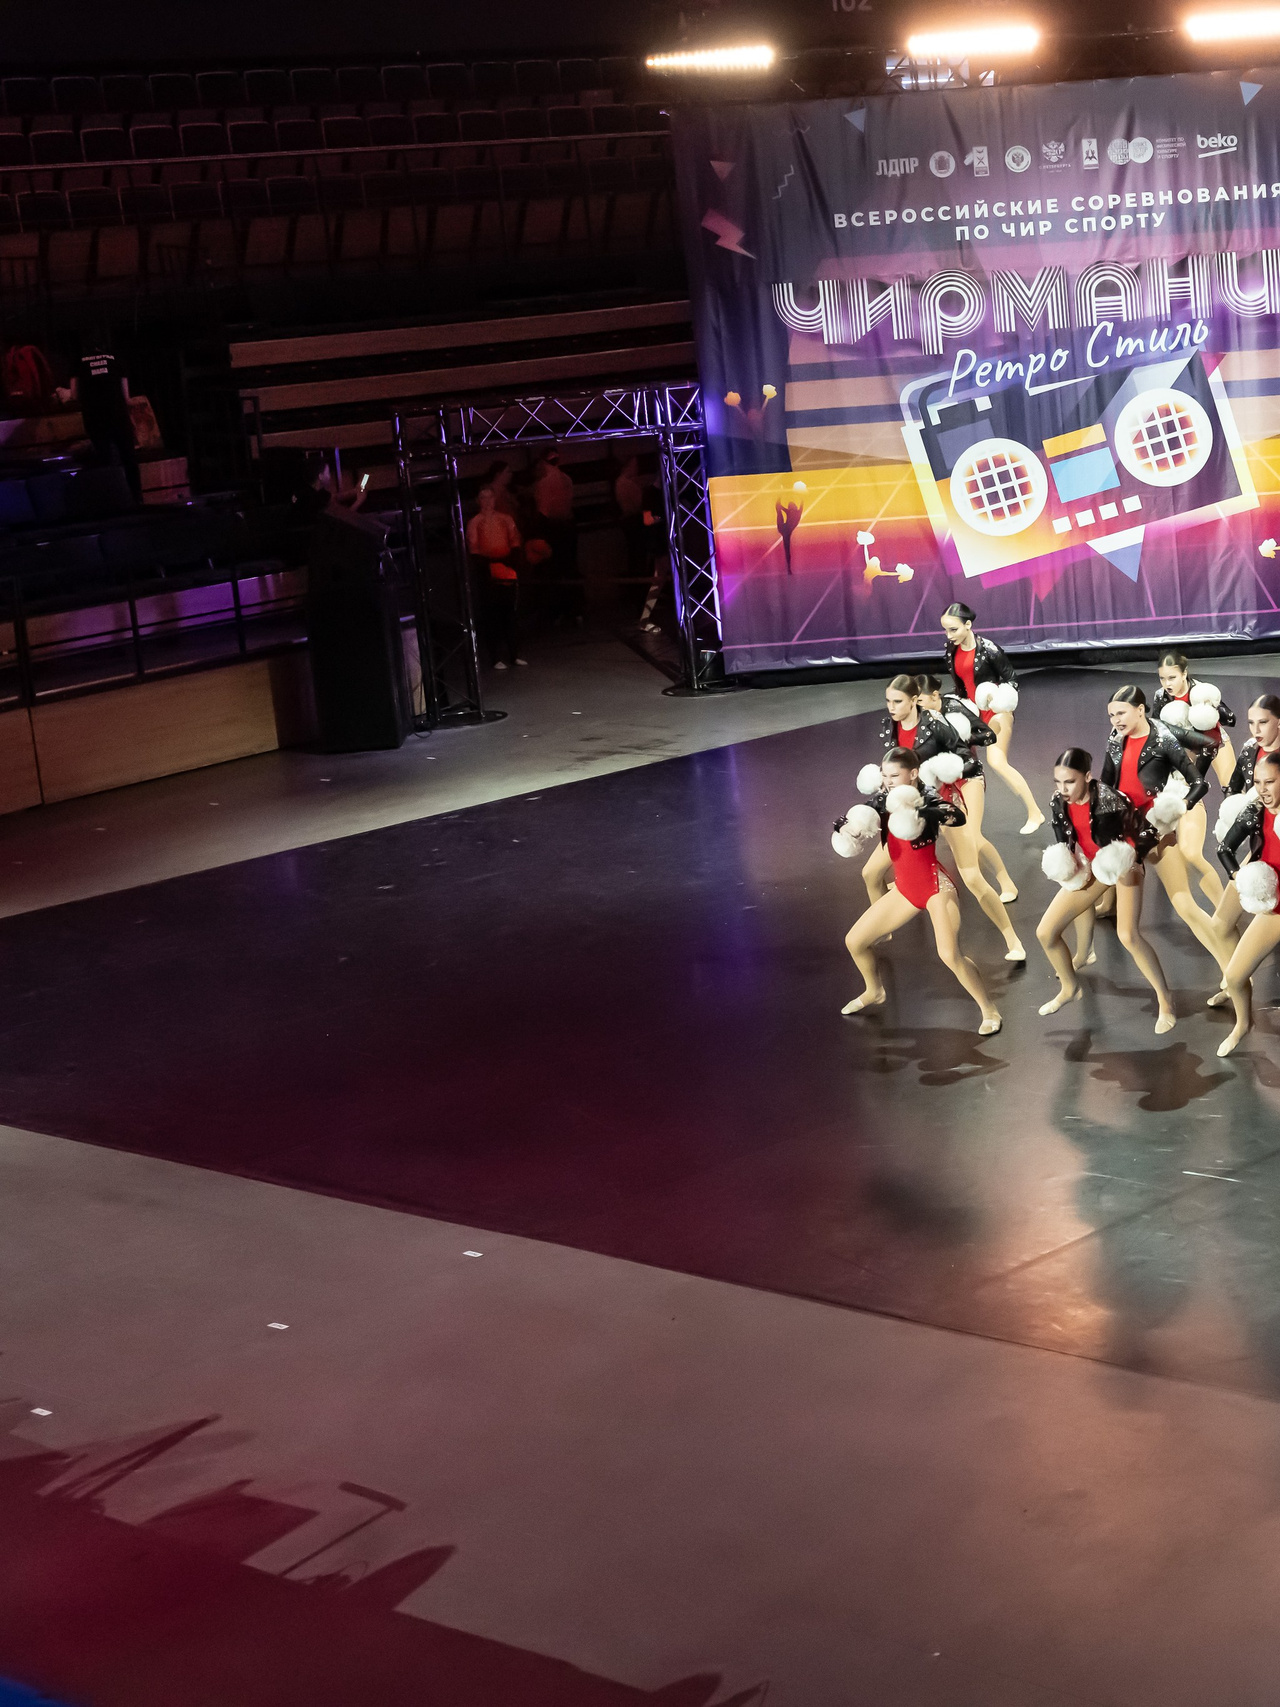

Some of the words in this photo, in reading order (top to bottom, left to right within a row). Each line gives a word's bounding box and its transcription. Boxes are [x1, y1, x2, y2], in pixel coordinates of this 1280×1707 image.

[1197, 133, 1237, 148] beko
[875, 157, 919, 178] ЛДПР
[834, 198, 1059, 229] ВСЕРОССИЙСКИЕ
[955, 224, 989, 241] ПО
[1001, 220, 1052, 238] ЧИР
[1064, 211, 1167, 234] СПОРТУ
[948, 348, 1070, 397] Ретро
[1086, 319, 1209, 368] Стиль
